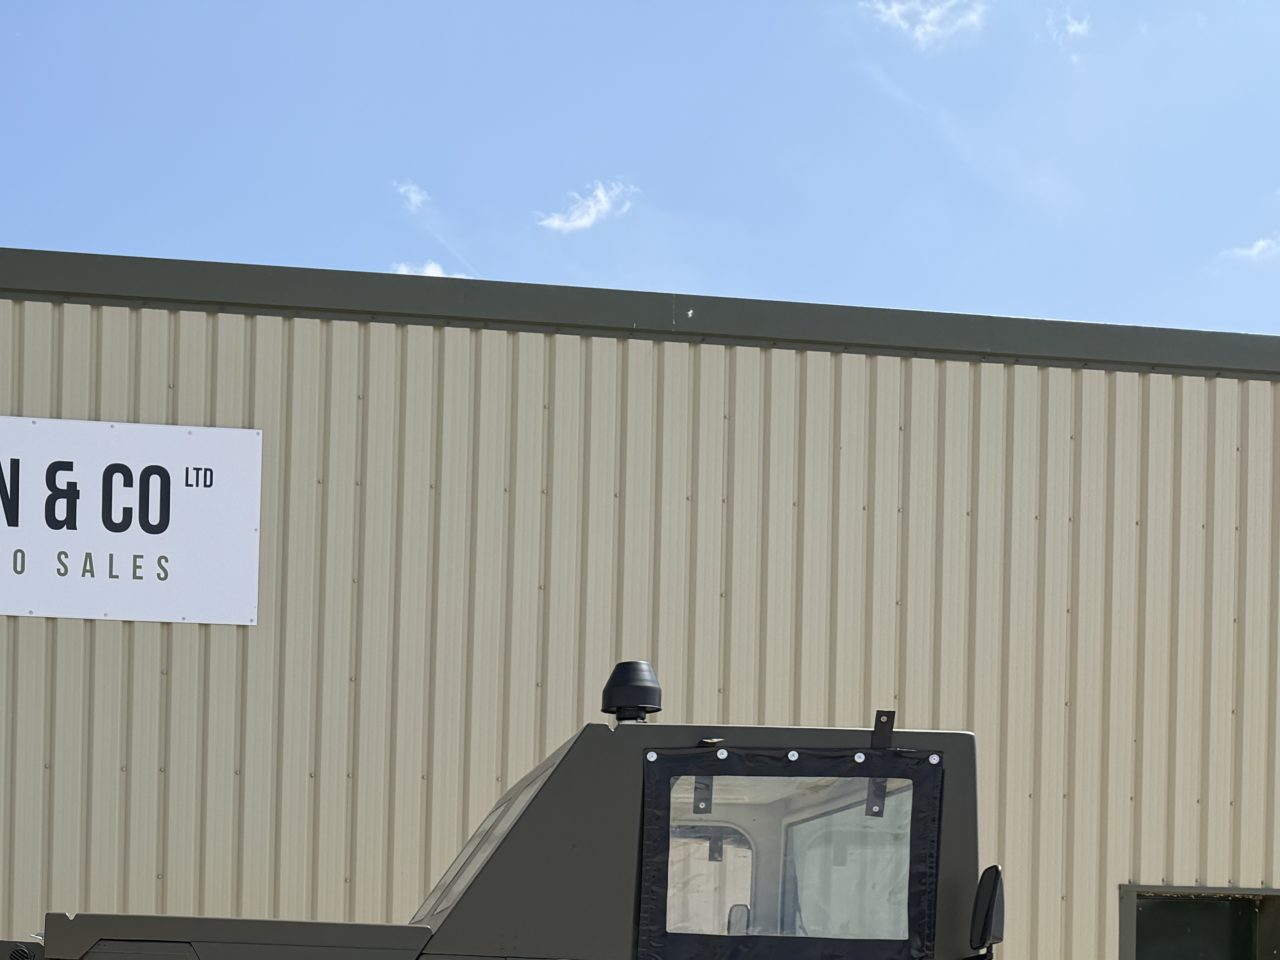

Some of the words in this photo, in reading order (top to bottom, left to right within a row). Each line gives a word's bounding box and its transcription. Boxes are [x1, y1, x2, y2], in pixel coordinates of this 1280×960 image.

[44, 460, 81, 531] &
[101, 462, 172, 535] CO
[184, 466, 214, 489] LTD
[56, 550, 169, 582] SALES
